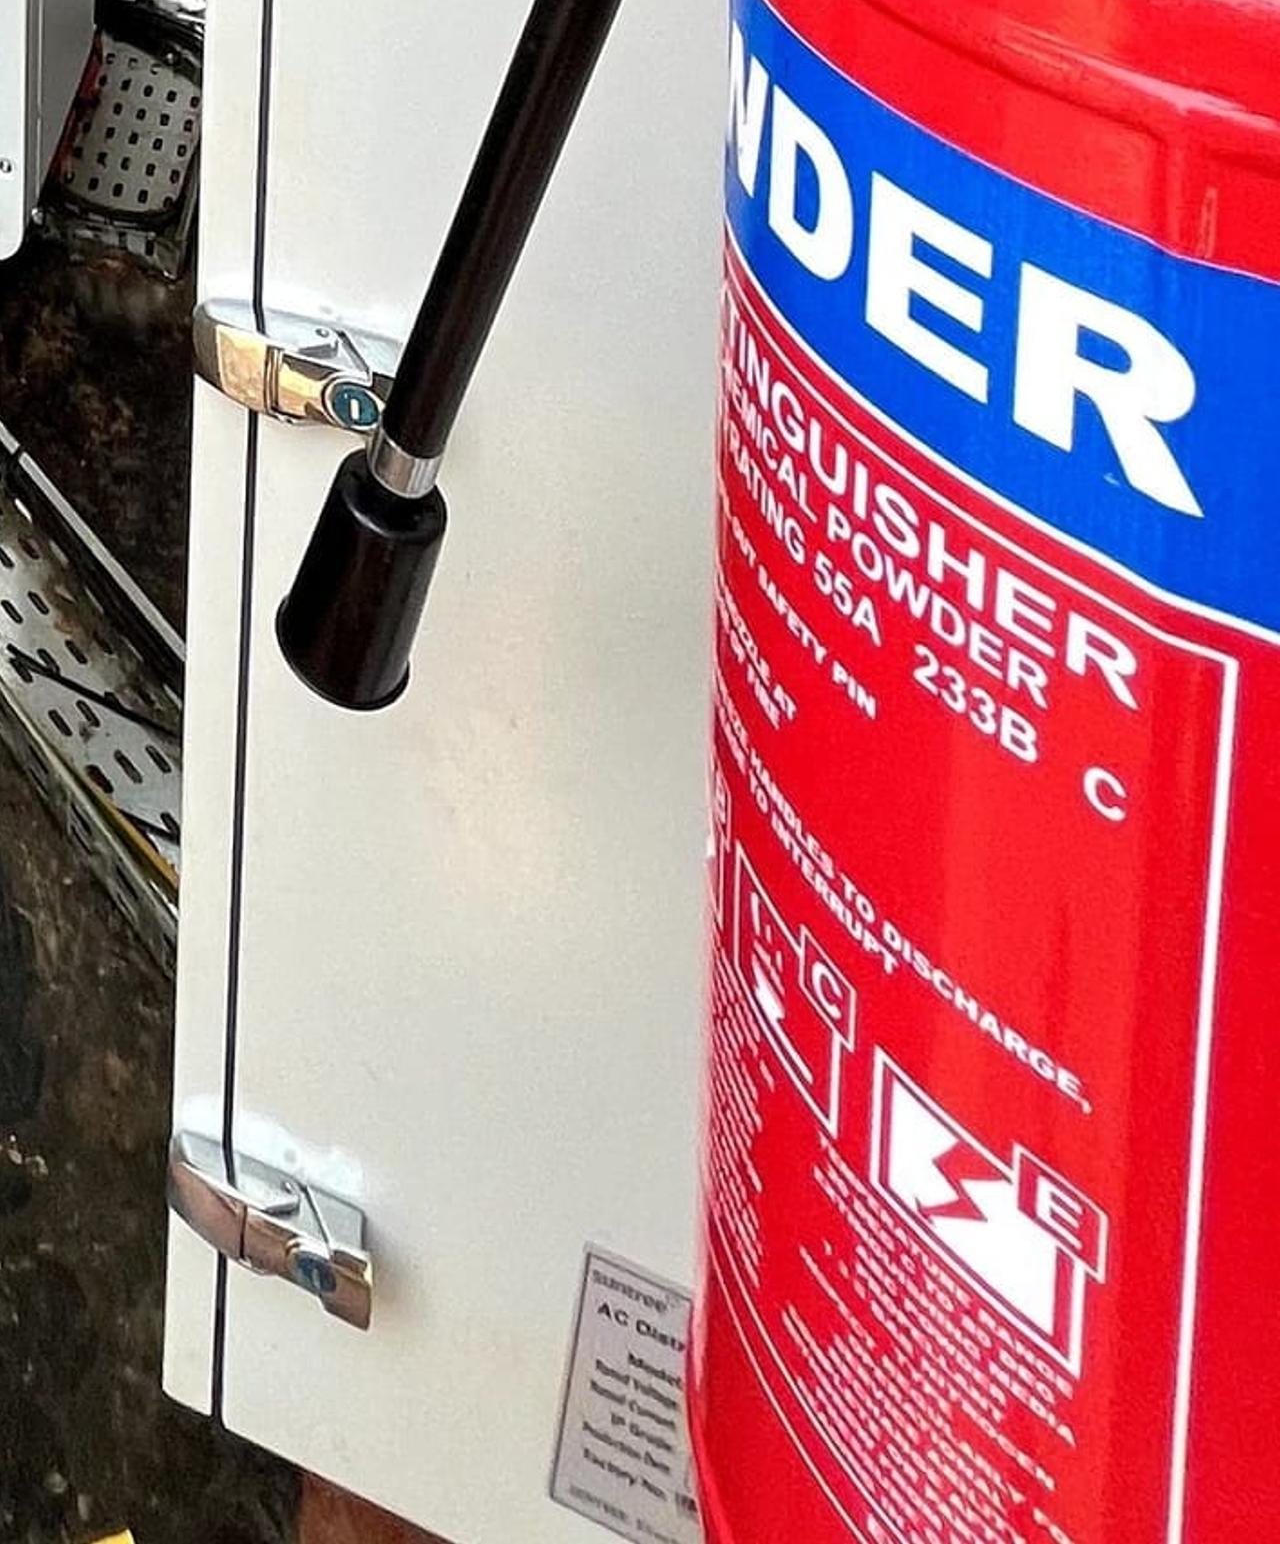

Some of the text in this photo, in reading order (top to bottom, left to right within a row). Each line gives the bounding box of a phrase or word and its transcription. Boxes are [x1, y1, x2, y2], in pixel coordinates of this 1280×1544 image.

[726, 17, 1204, 519] NDER
[721, 283, 1139, 711] TINGUISHER
[727, 419, 1129, 824] RATING 55A 233B C
[757, 565, 828, 666] SAFETY
[831, 660, 878, 720] PIN
[826, 502, 1049, 710] POWDER
[811, 960, 842, 1019] C
[840, 877, 875, 925] TO
[882, 919, 1092, 1115] DISCHARGE,
[597, 1301, 629, 1328] AC
[1034, 1176, 1083, 1251] E
